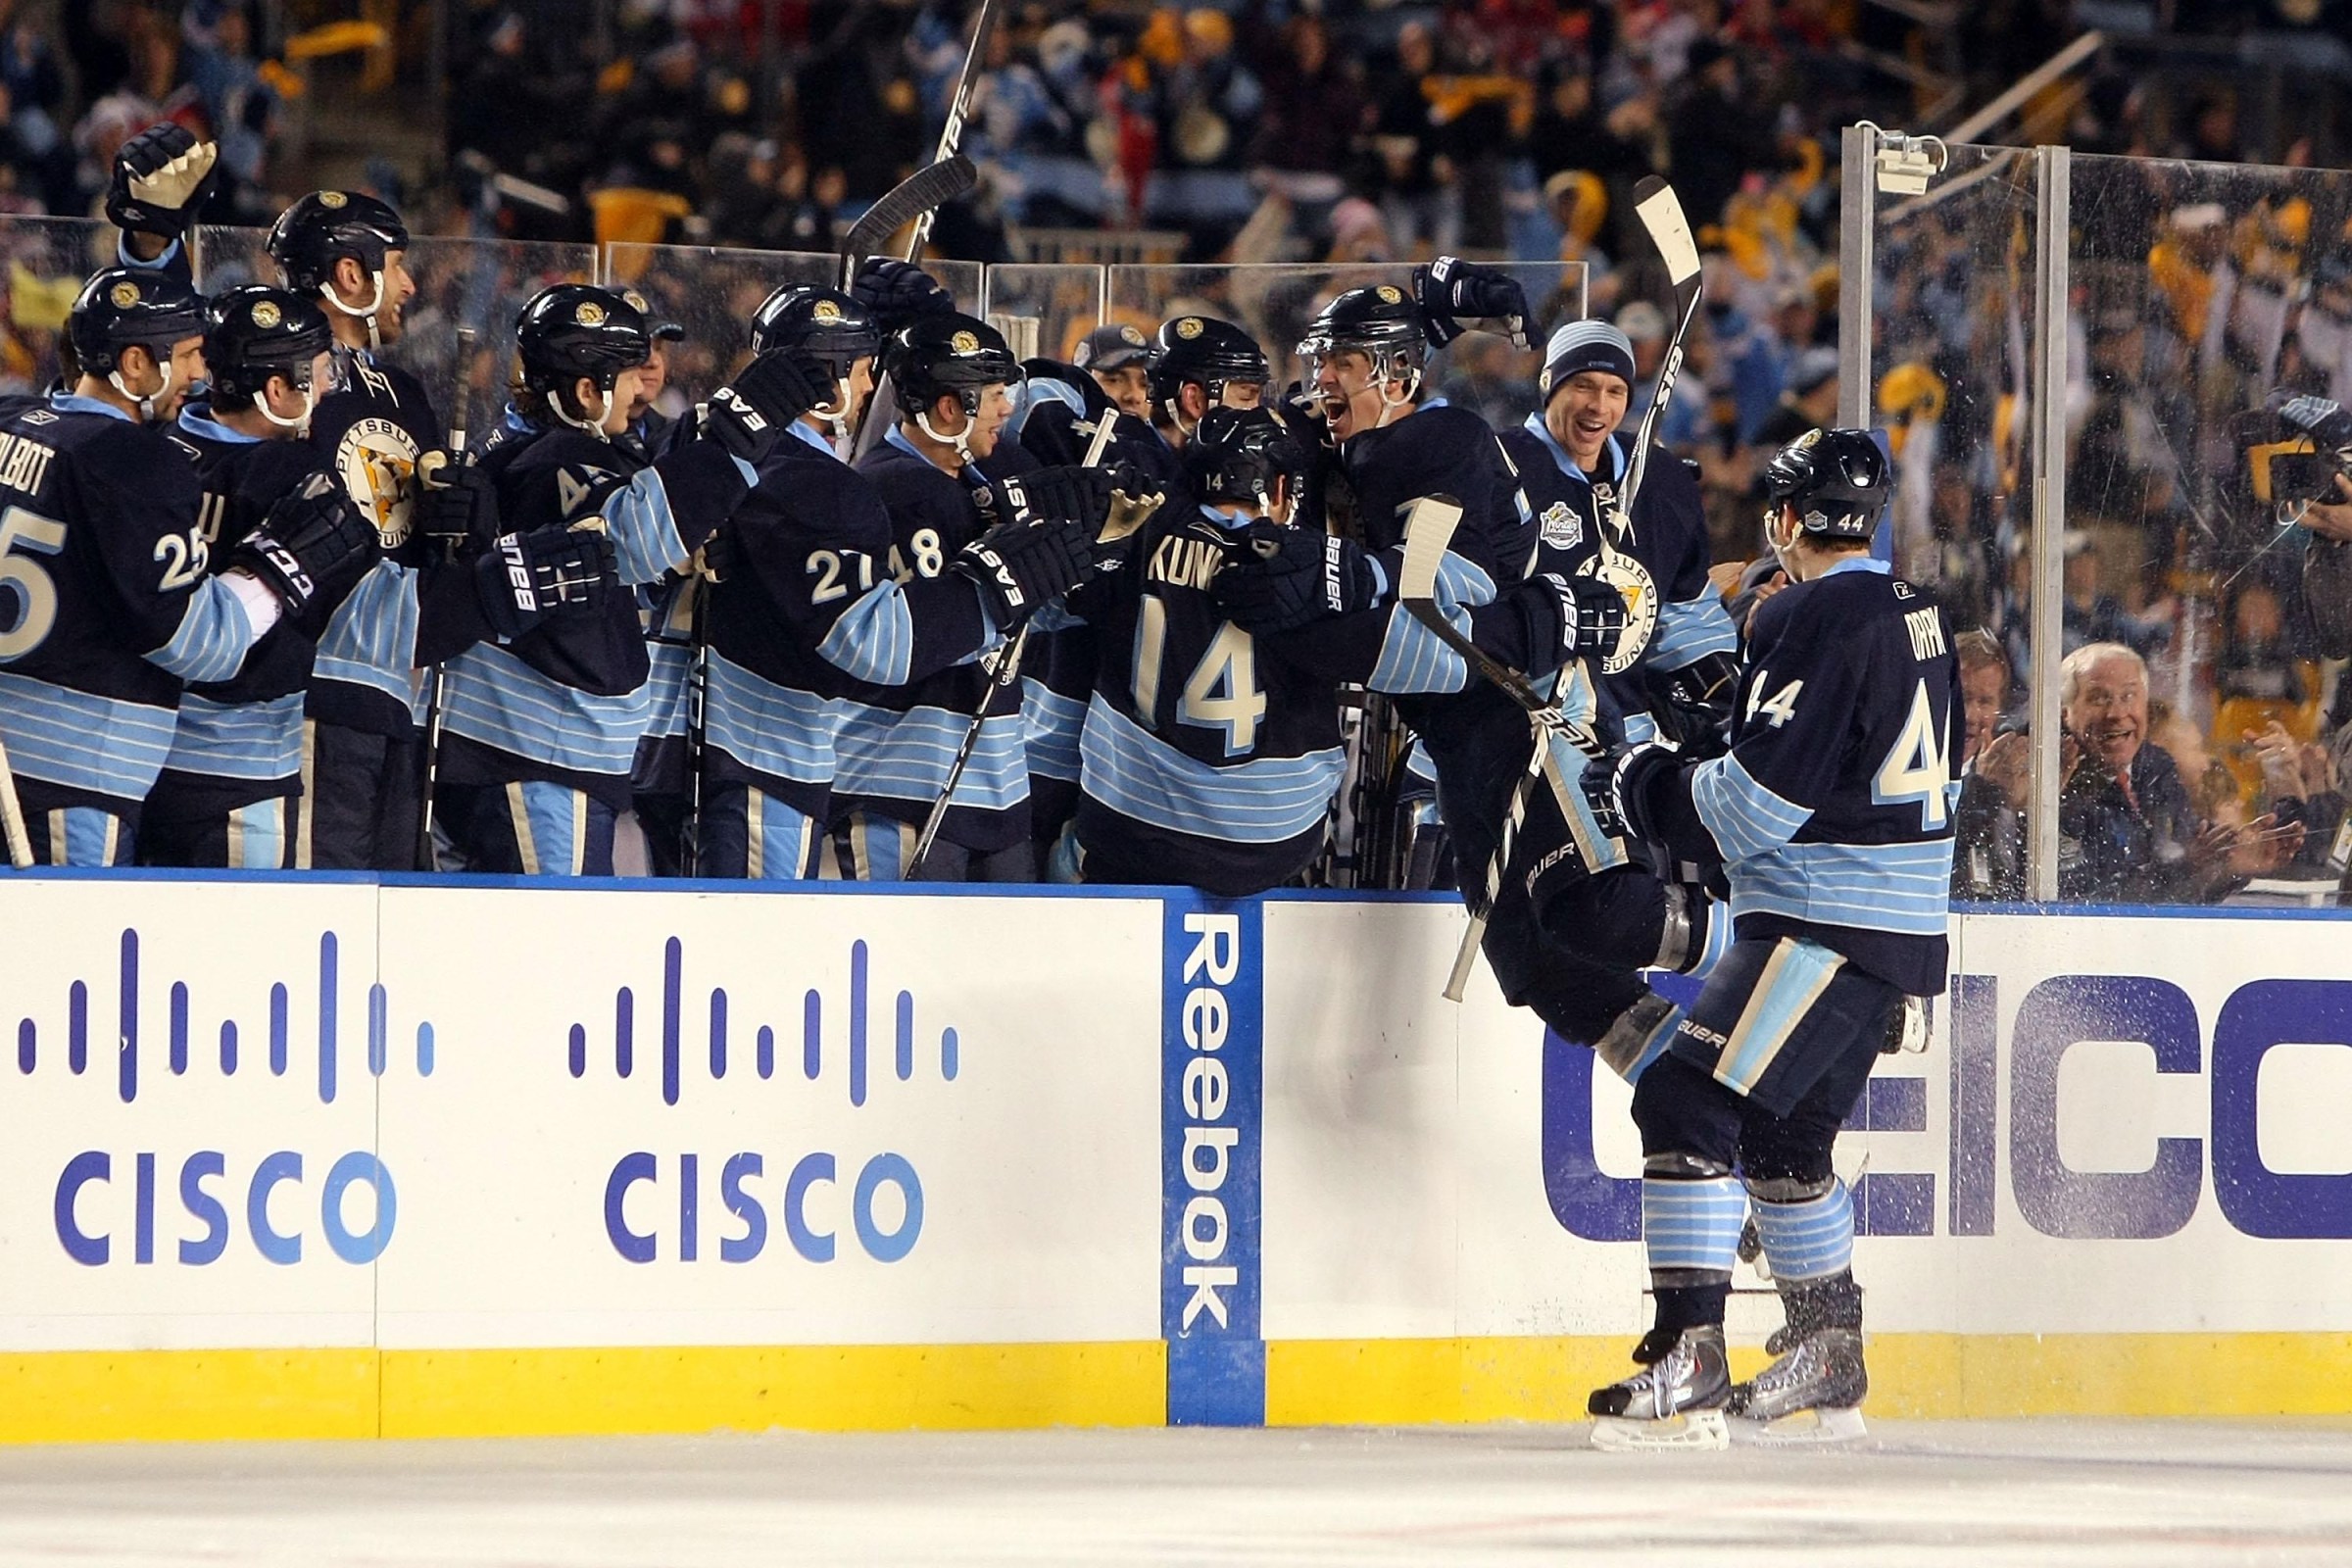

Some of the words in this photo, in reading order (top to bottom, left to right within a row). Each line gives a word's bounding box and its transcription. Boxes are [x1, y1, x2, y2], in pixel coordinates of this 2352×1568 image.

[1205, 472, 1224, 491] 14
[1838, 513, 1865, 532] 44
[806, 549, 873, 605] 27
[963, 541, 1025, 608] EAST
[1129, 593, 1267, 758] 14
[1182, 912, 1240, 1331] Reebok
[54, 1150, 397, 1266] CISCO
[604, 1151, 925, 1263] CISCO
